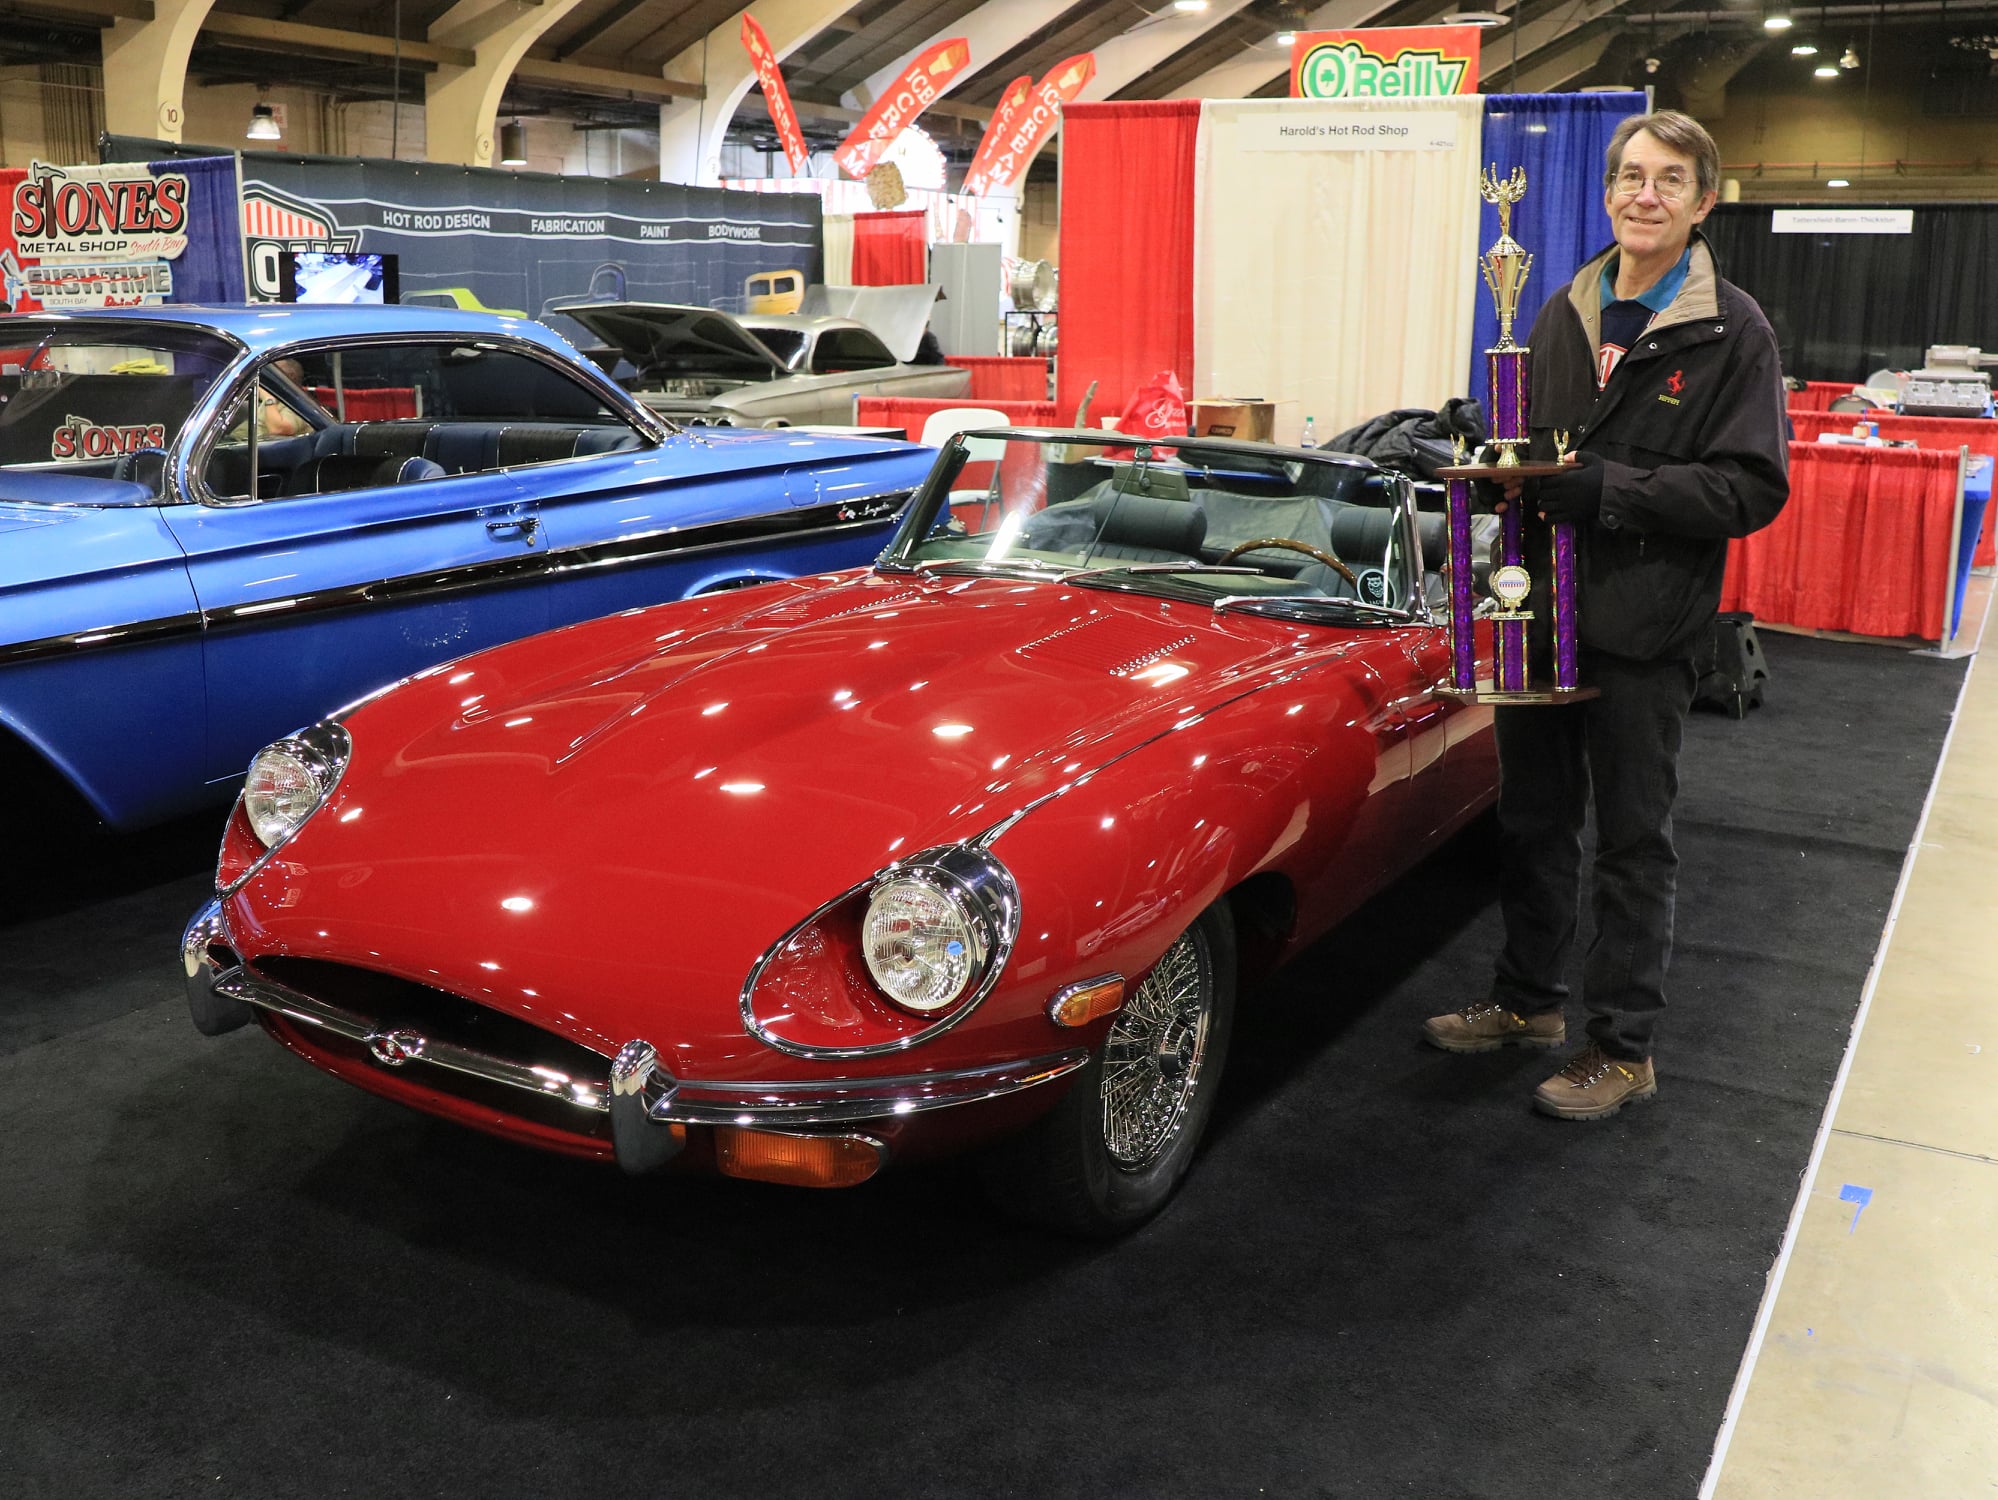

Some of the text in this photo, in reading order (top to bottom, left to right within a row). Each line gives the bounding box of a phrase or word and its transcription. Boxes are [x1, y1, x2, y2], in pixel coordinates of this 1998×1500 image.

[1308, 51, 1456, 97] O'Reilly
[167, 109, 178, 123] 10
[842, 67, 935, 176] ICE CREAM
[1279, 125, 1409, 137] Harold's Hot Rod Shop
[988, 105, 1048, 184] CREAM
[16, 162, 187, 239] STONES
[383, 210, 490, 229] HOT ROD DESIGN
[531, 219, 605, 233] FABRICATION
[641, 225, 671, 238] PAINT
[709, 224, 761, 238] BODYWORK
[20, 236, 185, 256] METAL SHOP South Bay
[28, 265, 171, 295] SHOWTIME
[53, 415, 164, 458] STONES
